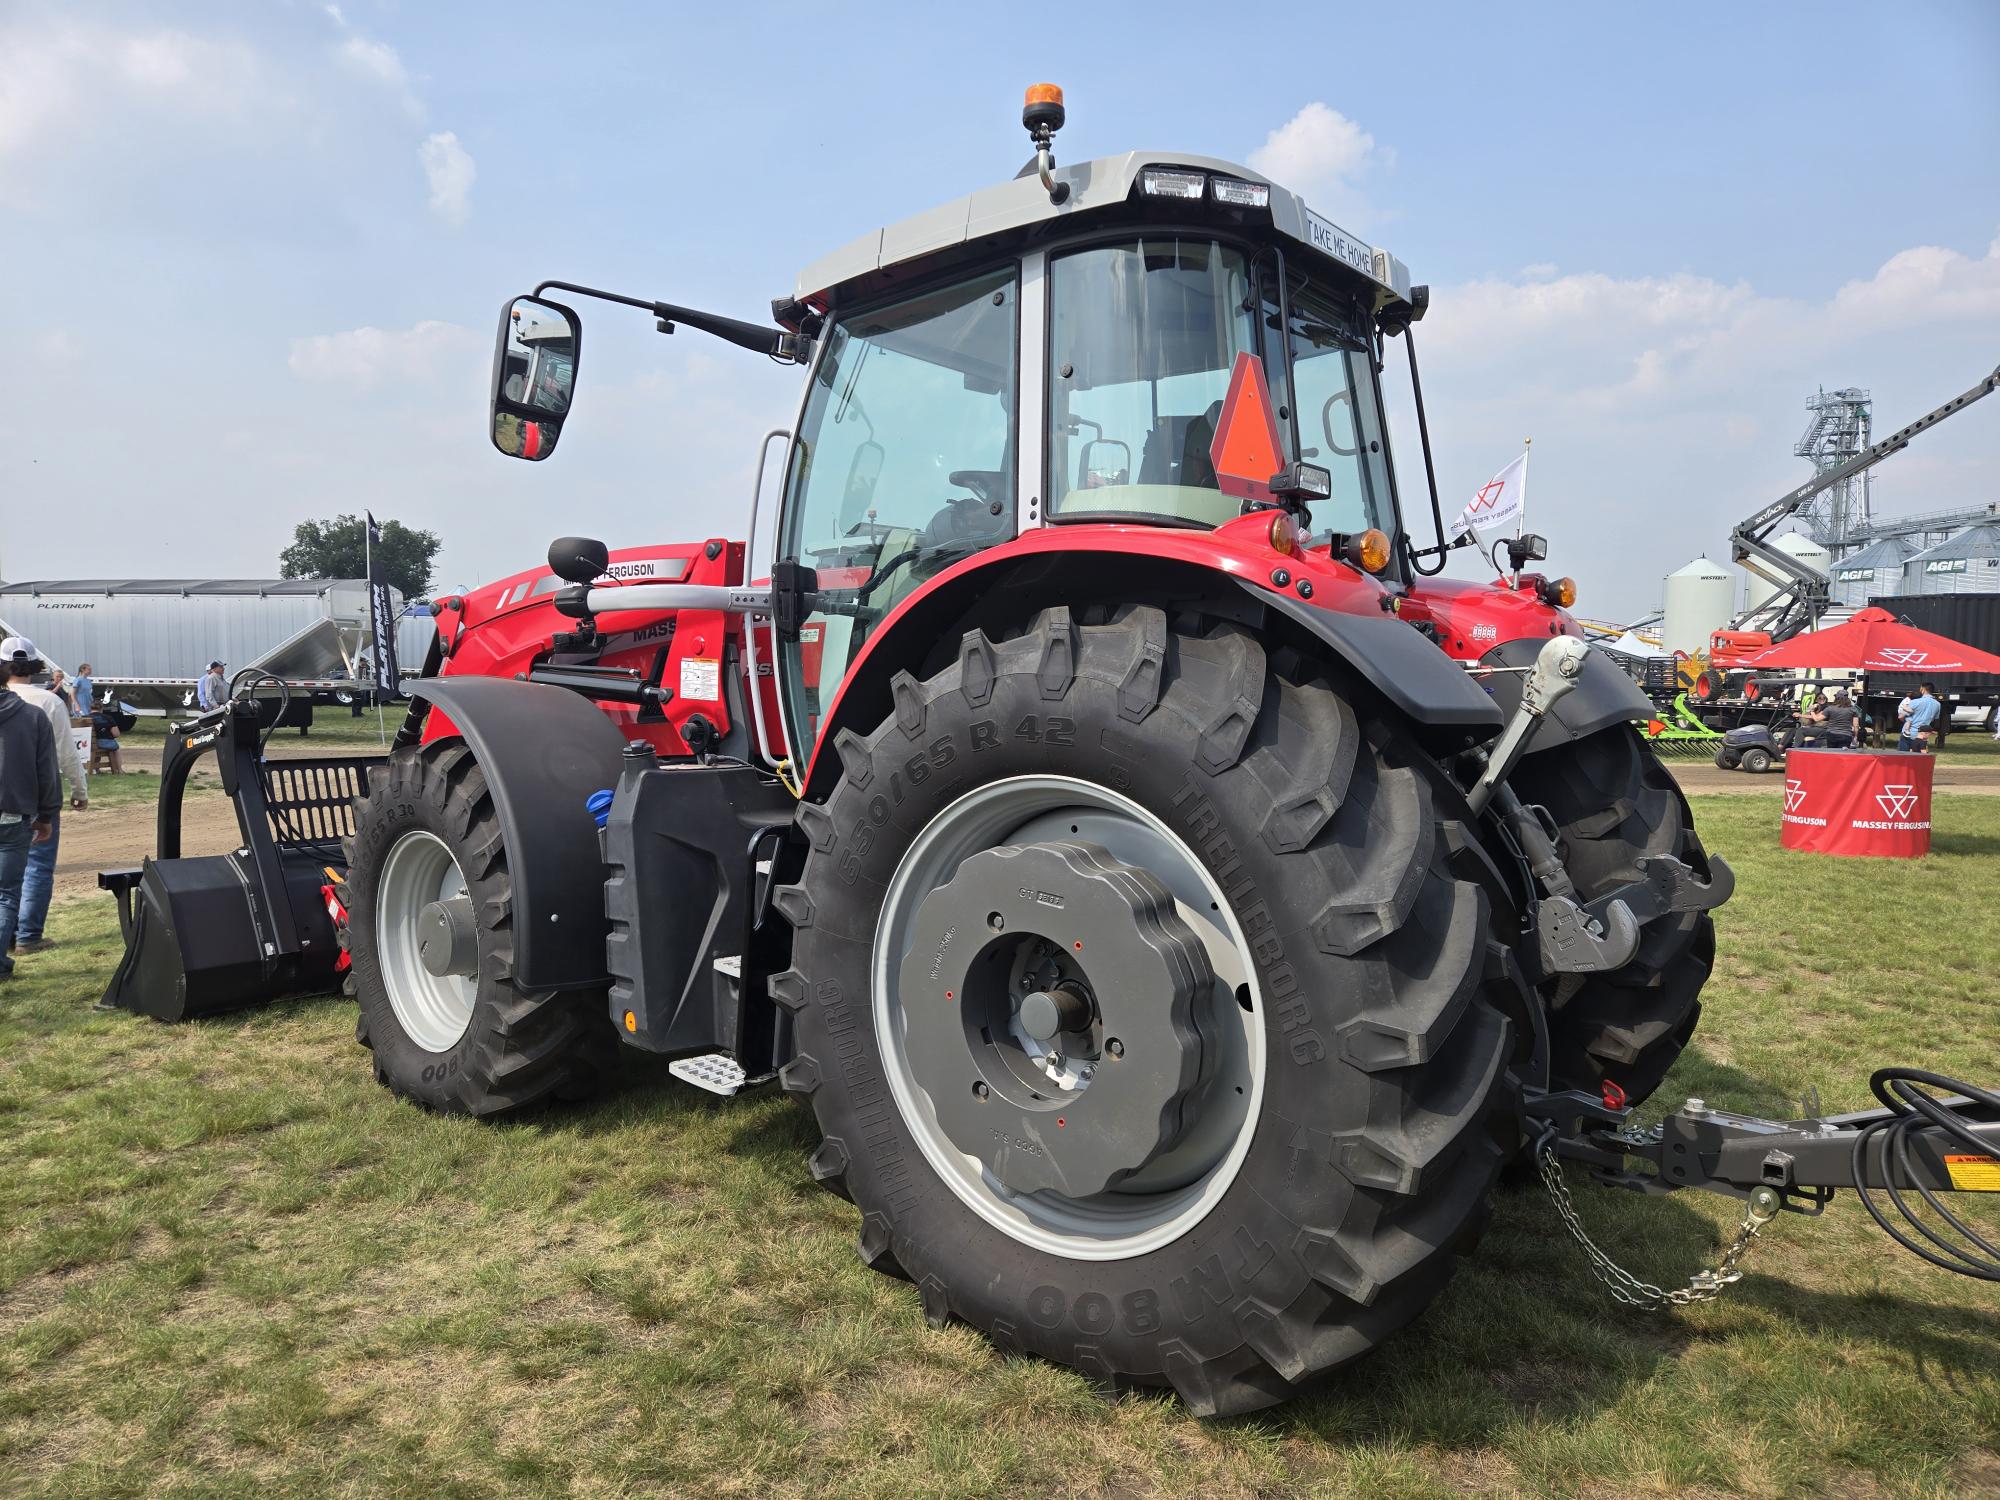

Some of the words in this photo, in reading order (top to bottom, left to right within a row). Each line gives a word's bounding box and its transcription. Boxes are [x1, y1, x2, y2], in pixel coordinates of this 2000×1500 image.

[1308, 219, 1332, 251] TAKE
[1333, 234, 1346, 260] ME
[1347, 243, 1371, 274] HOME
[1755, 503, 1784, 524] SKYJACK
[1839, 570, 1863, 581] AGI
[1926, 560, 1952, 573] AGI
[373, 583, 390, 690] PLATINUM
[968, 718, 1001, 752] R
[1014, 713, 1077, 747] 42
[386, 808, 398, 823] R
[398, 803, 416, 817] 30
[1787, 814, 1827, 827] FERGUSON
[1852, 820, 1892, 830] MASSEY
[1168, 768, 1327, 1067] TRELLEBORG
[814, 976, 920, 1226] TRELLEBORG
[1169, 1224, 1276, 1325] TM
[1025, 1284, 1163, 1337] 800
